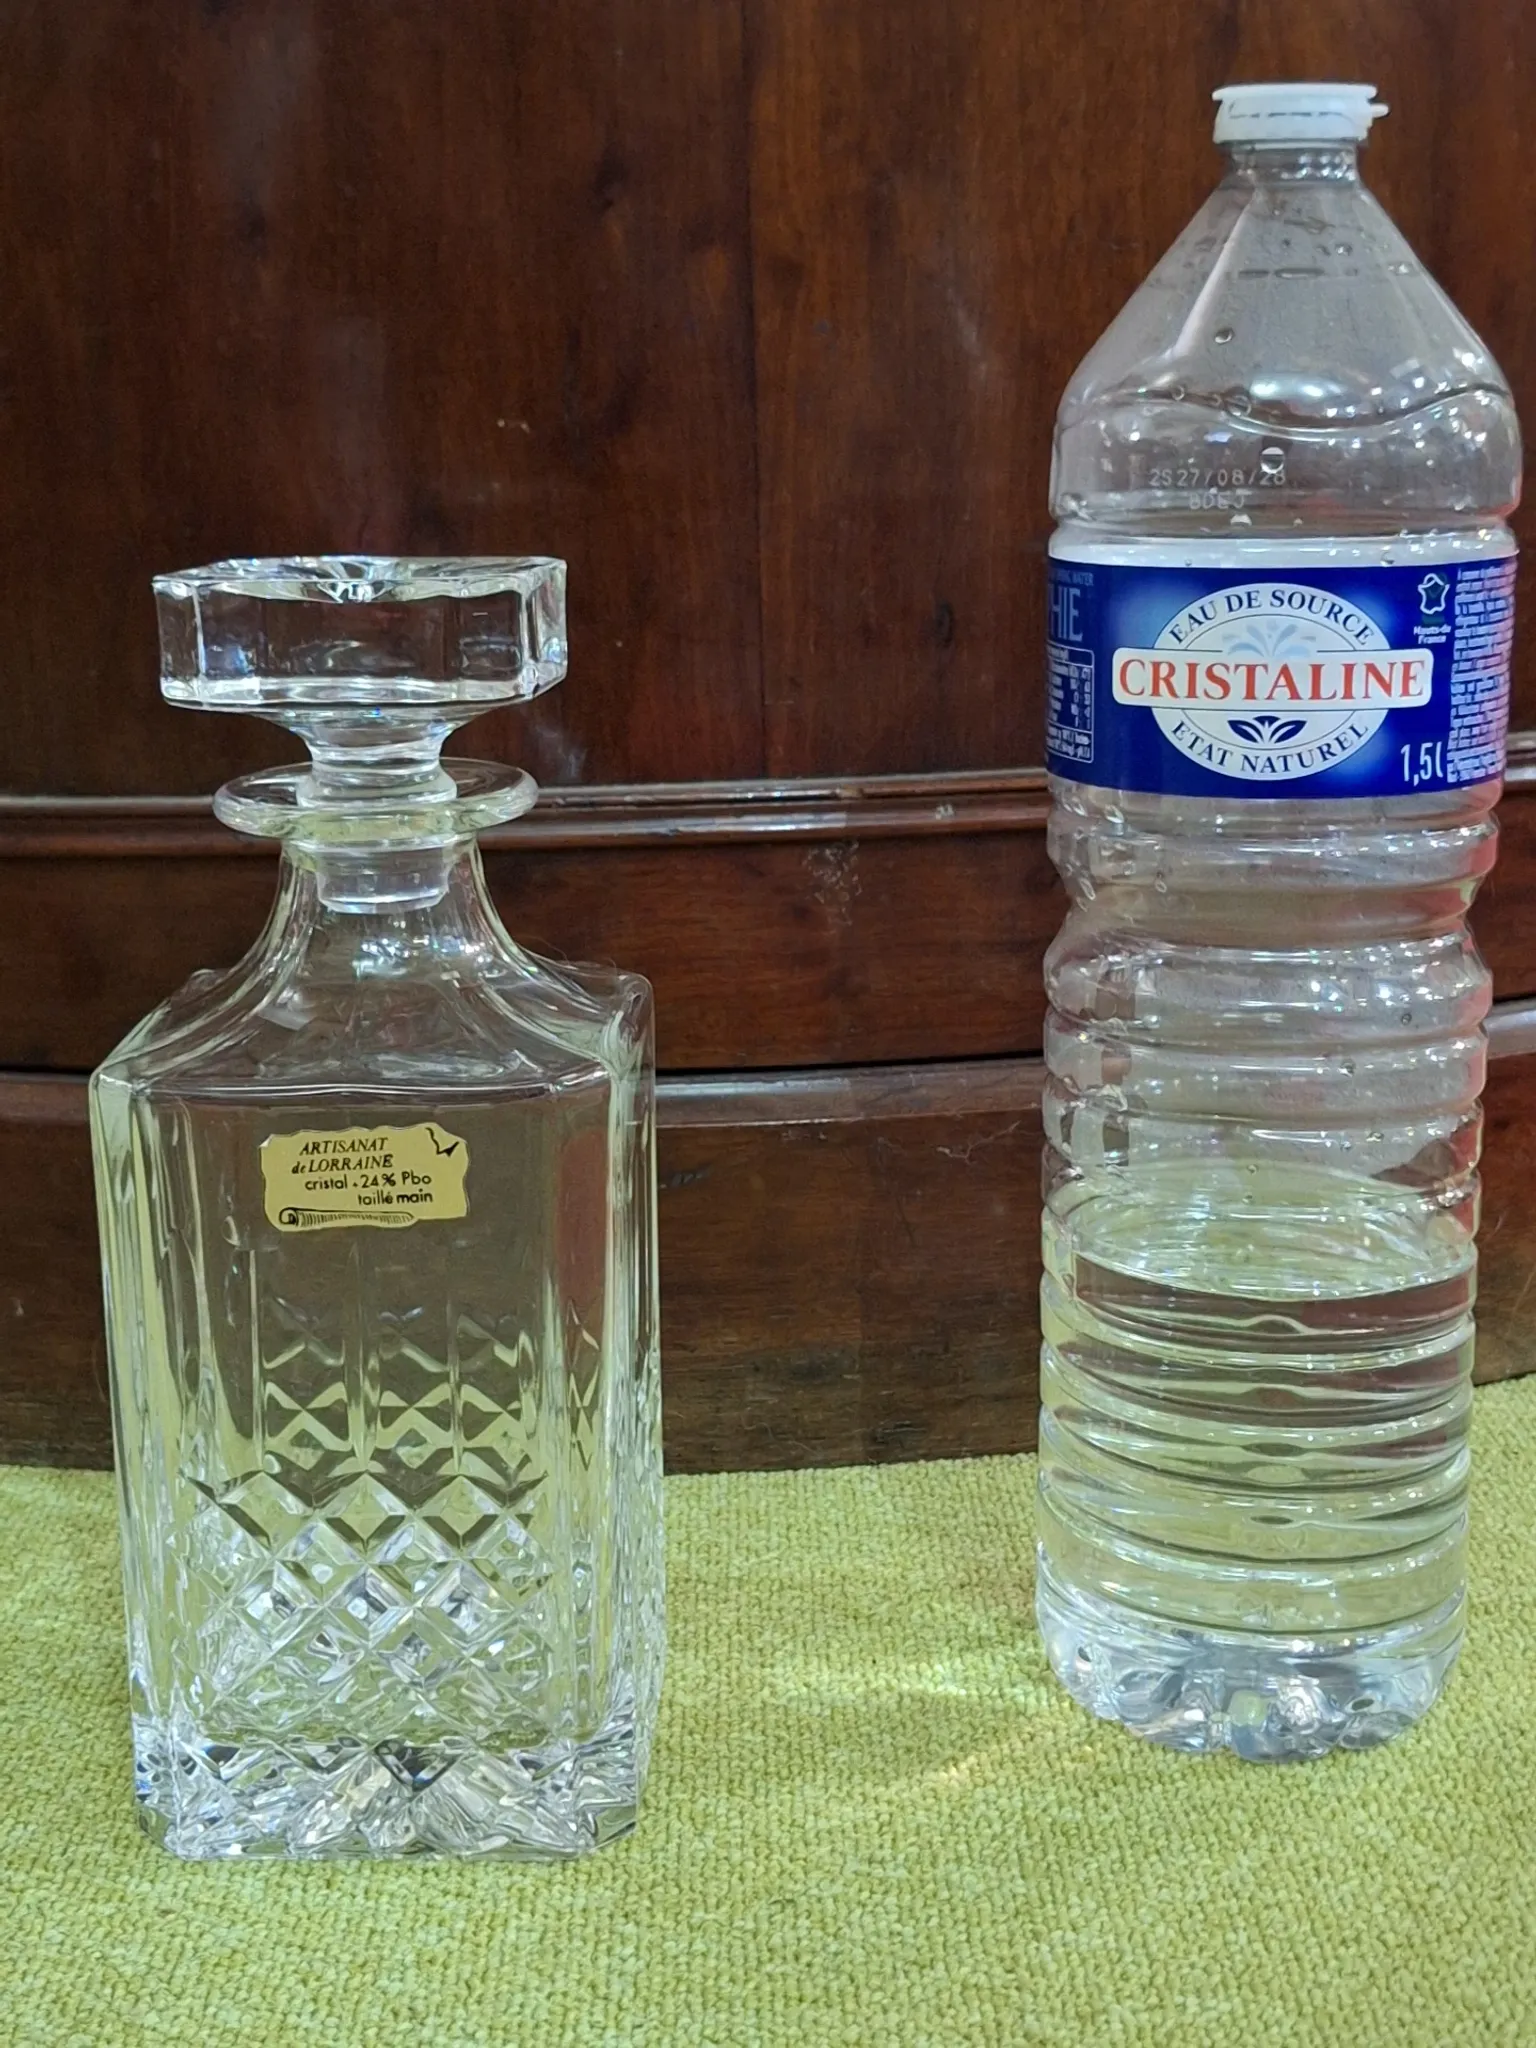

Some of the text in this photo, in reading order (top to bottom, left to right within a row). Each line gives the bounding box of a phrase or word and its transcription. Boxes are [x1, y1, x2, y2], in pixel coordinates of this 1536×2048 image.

[1168, 589, 1375, 645] EAU DE SOURCE
[1119, 659, 1425, 701] CRISTALINE
[1171, 720, 1369, 774] ETAT NATUREL
[299, 1137, 389, 1157] ARTISANAT
[291, 1153, 394, 1175] de LORRAINE
[305, 1173, 348, 1191] cristal
[402, 1171, 432, 1186] Pbo
[396, 1188, 433, 1205] main
